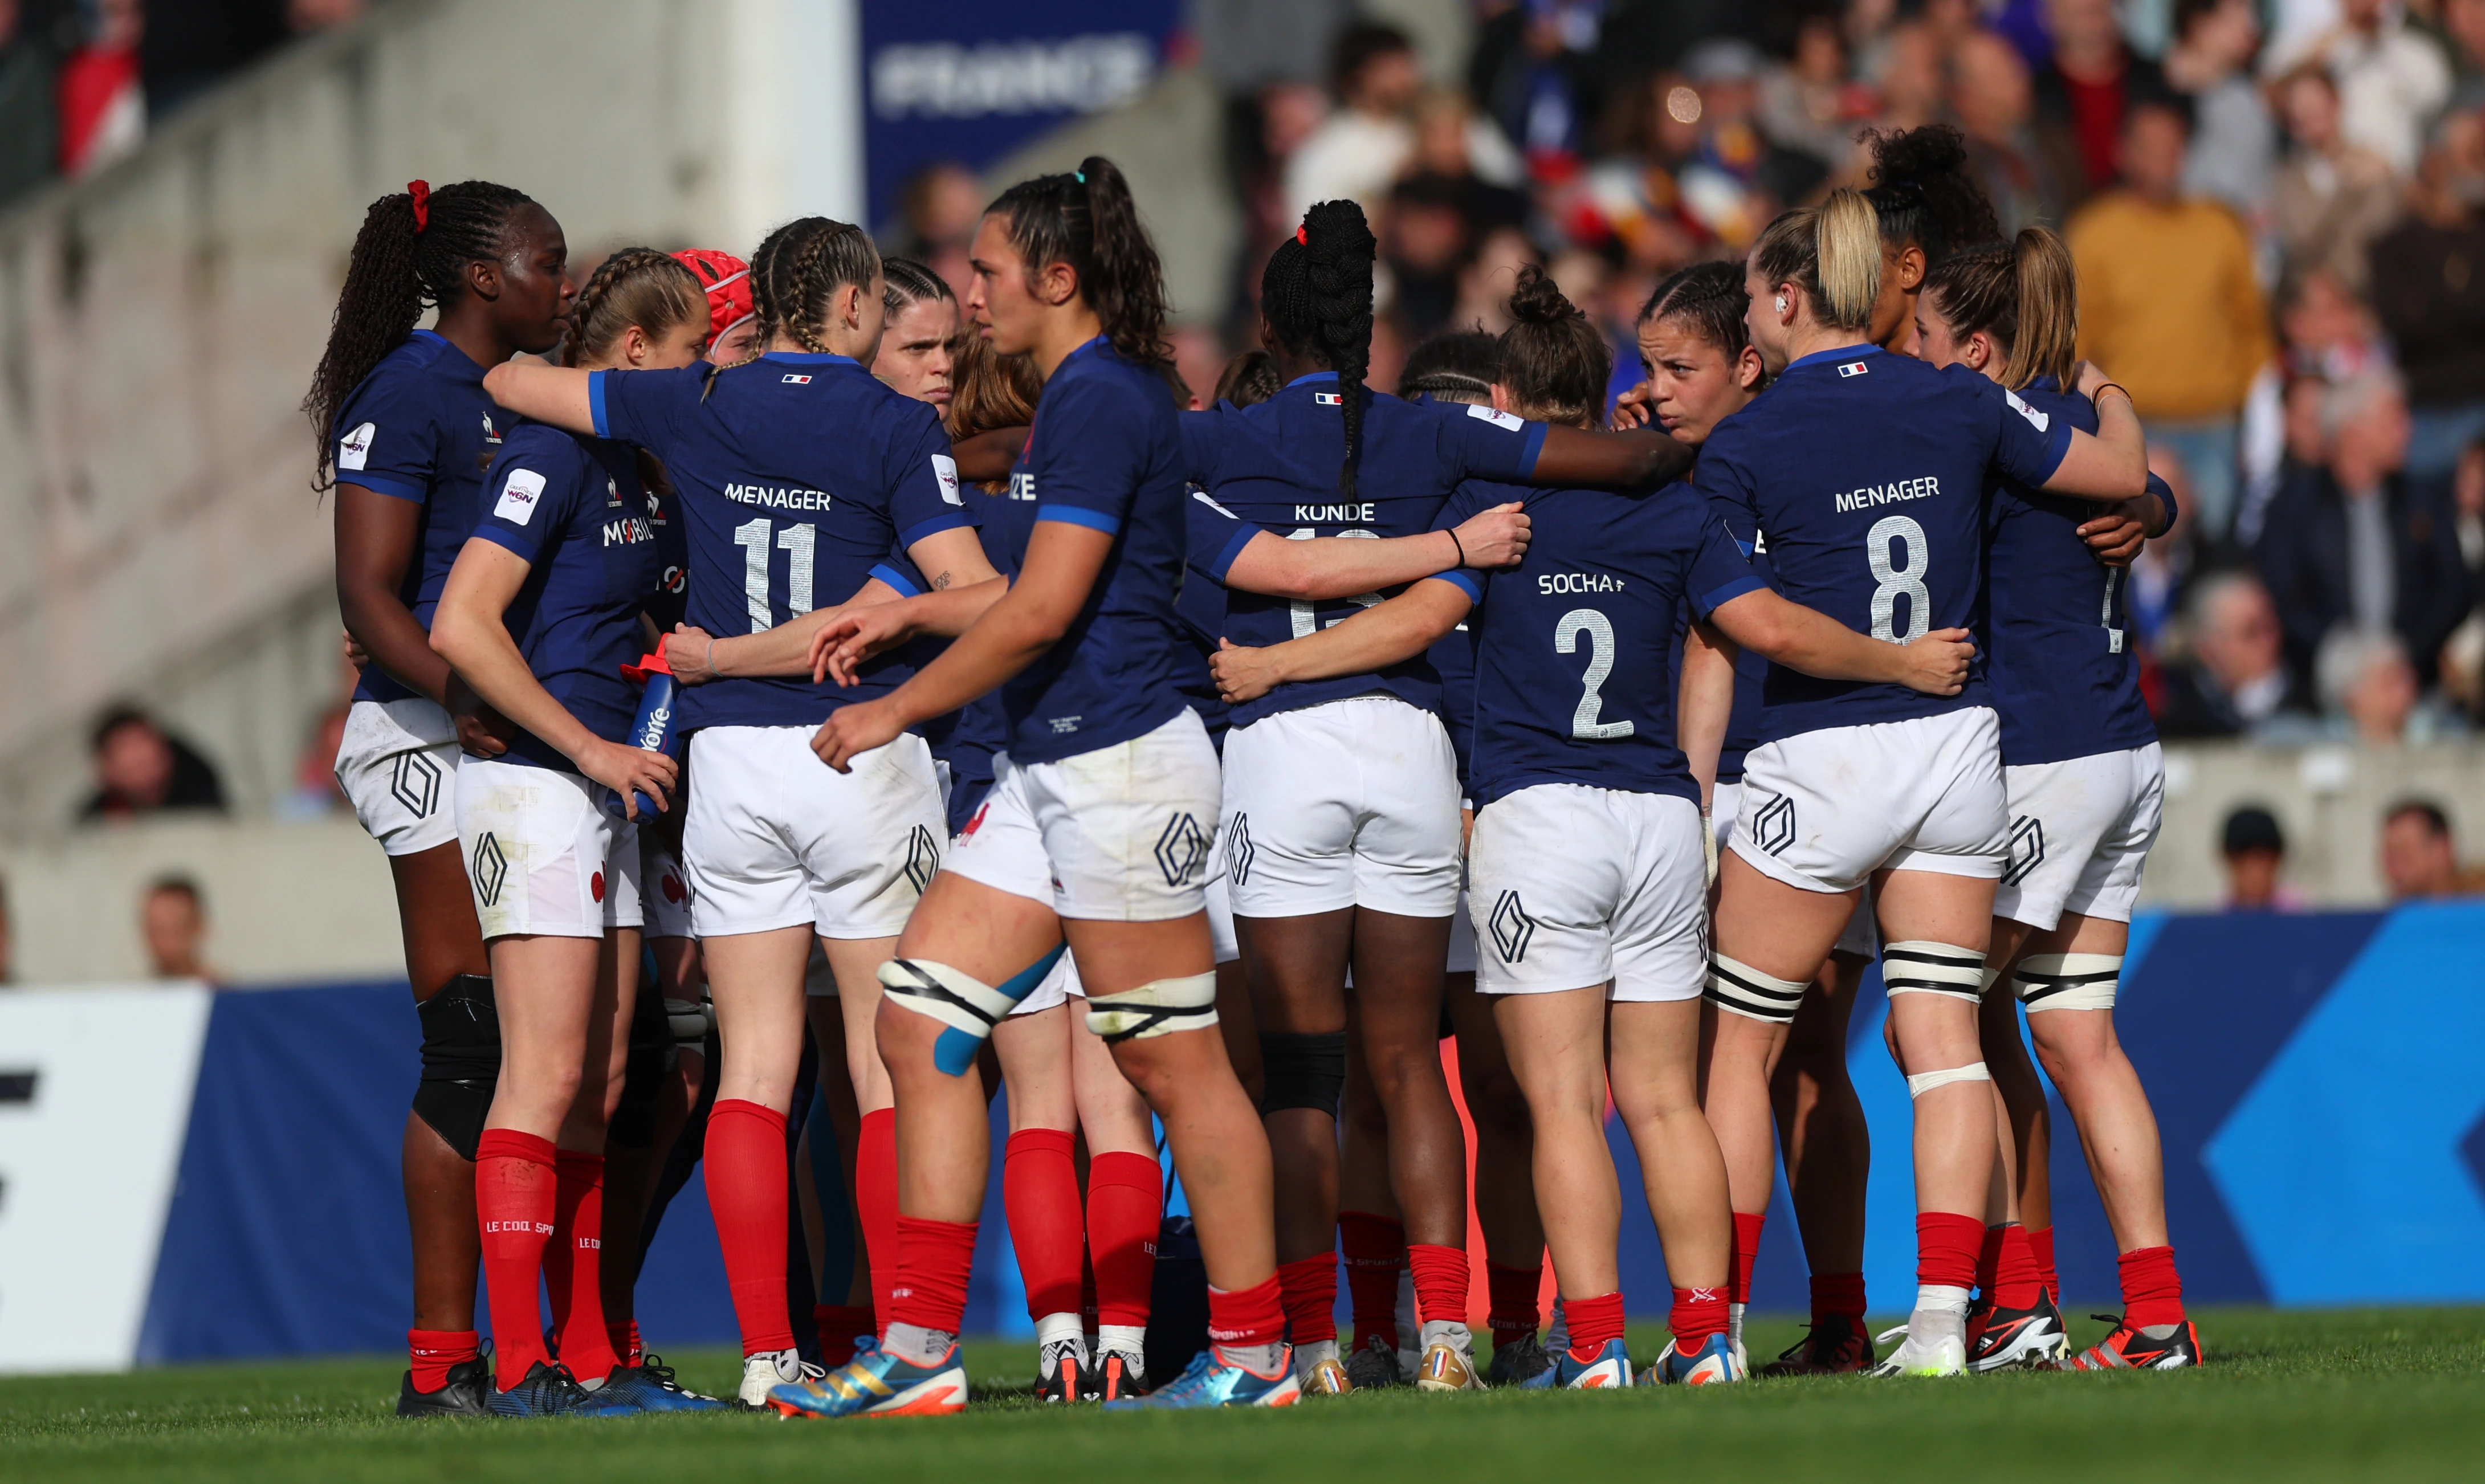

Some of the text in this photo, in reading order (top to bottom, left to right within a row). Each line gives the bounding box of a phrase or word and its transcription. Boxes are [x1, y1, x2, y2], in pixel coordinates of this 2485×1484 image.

[724, 483, 830, 511] MENAGER
[1835, 476, 1940, 513] MENAGER
[1295, 503, 1375, 521] KONDE
[603, 516, 654, 547] MOBIL
[734, 518, 815, 635] 11
[1867, 515, 1929, 646] 8
[1555, 609, 1634, 739] 2
[487, 1221, 499, 1233] LE
[580, 1238, 590, 1248] LE
